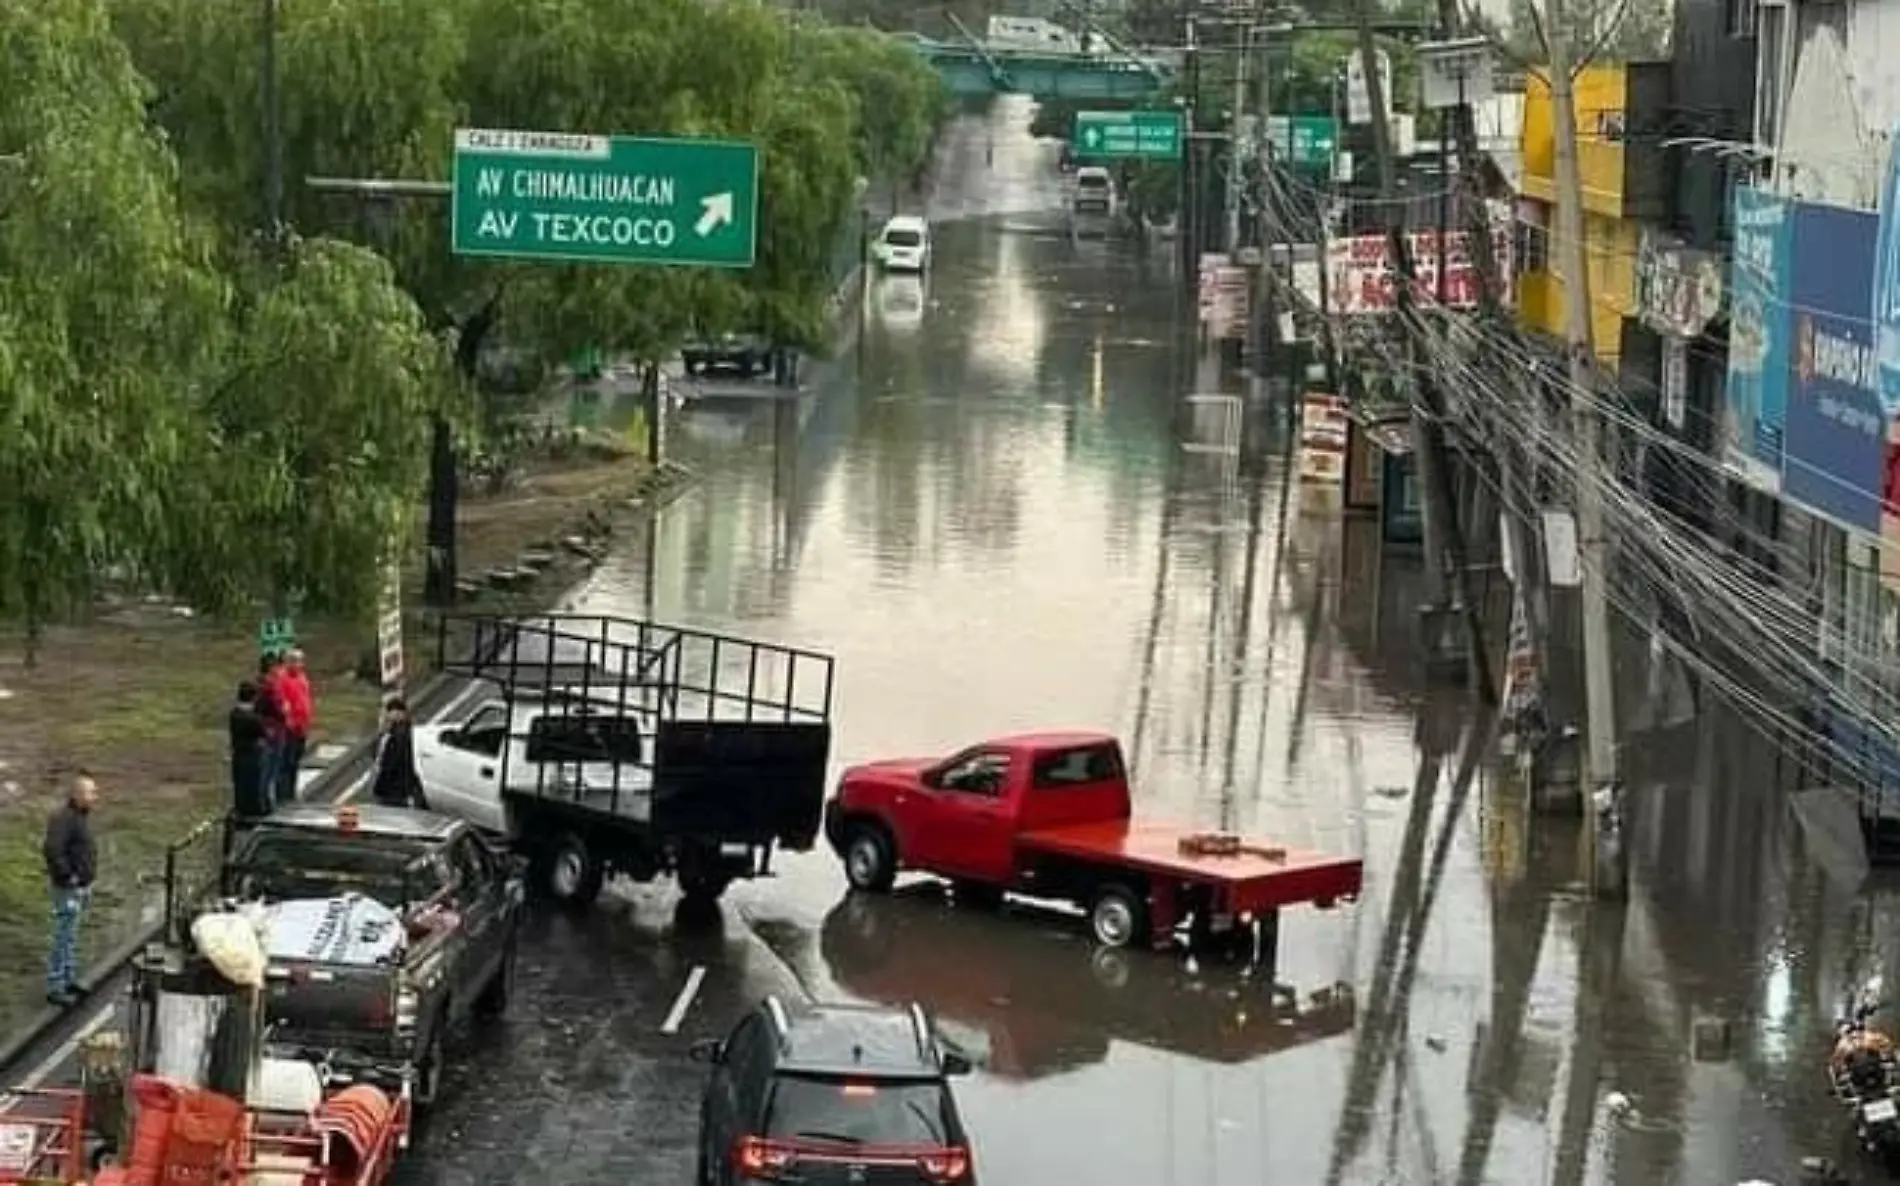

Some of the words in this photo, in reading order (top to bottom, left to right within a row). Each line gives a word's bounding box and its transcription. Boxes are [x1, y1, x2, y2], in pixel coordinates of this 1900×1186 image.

[477, 168, 504, 197] AV
[512, 169, 675, 206] CHIMALHUACAN
[477, 209, 519, 239] AV
[531, 213, 675, 247] TEXCOCO
